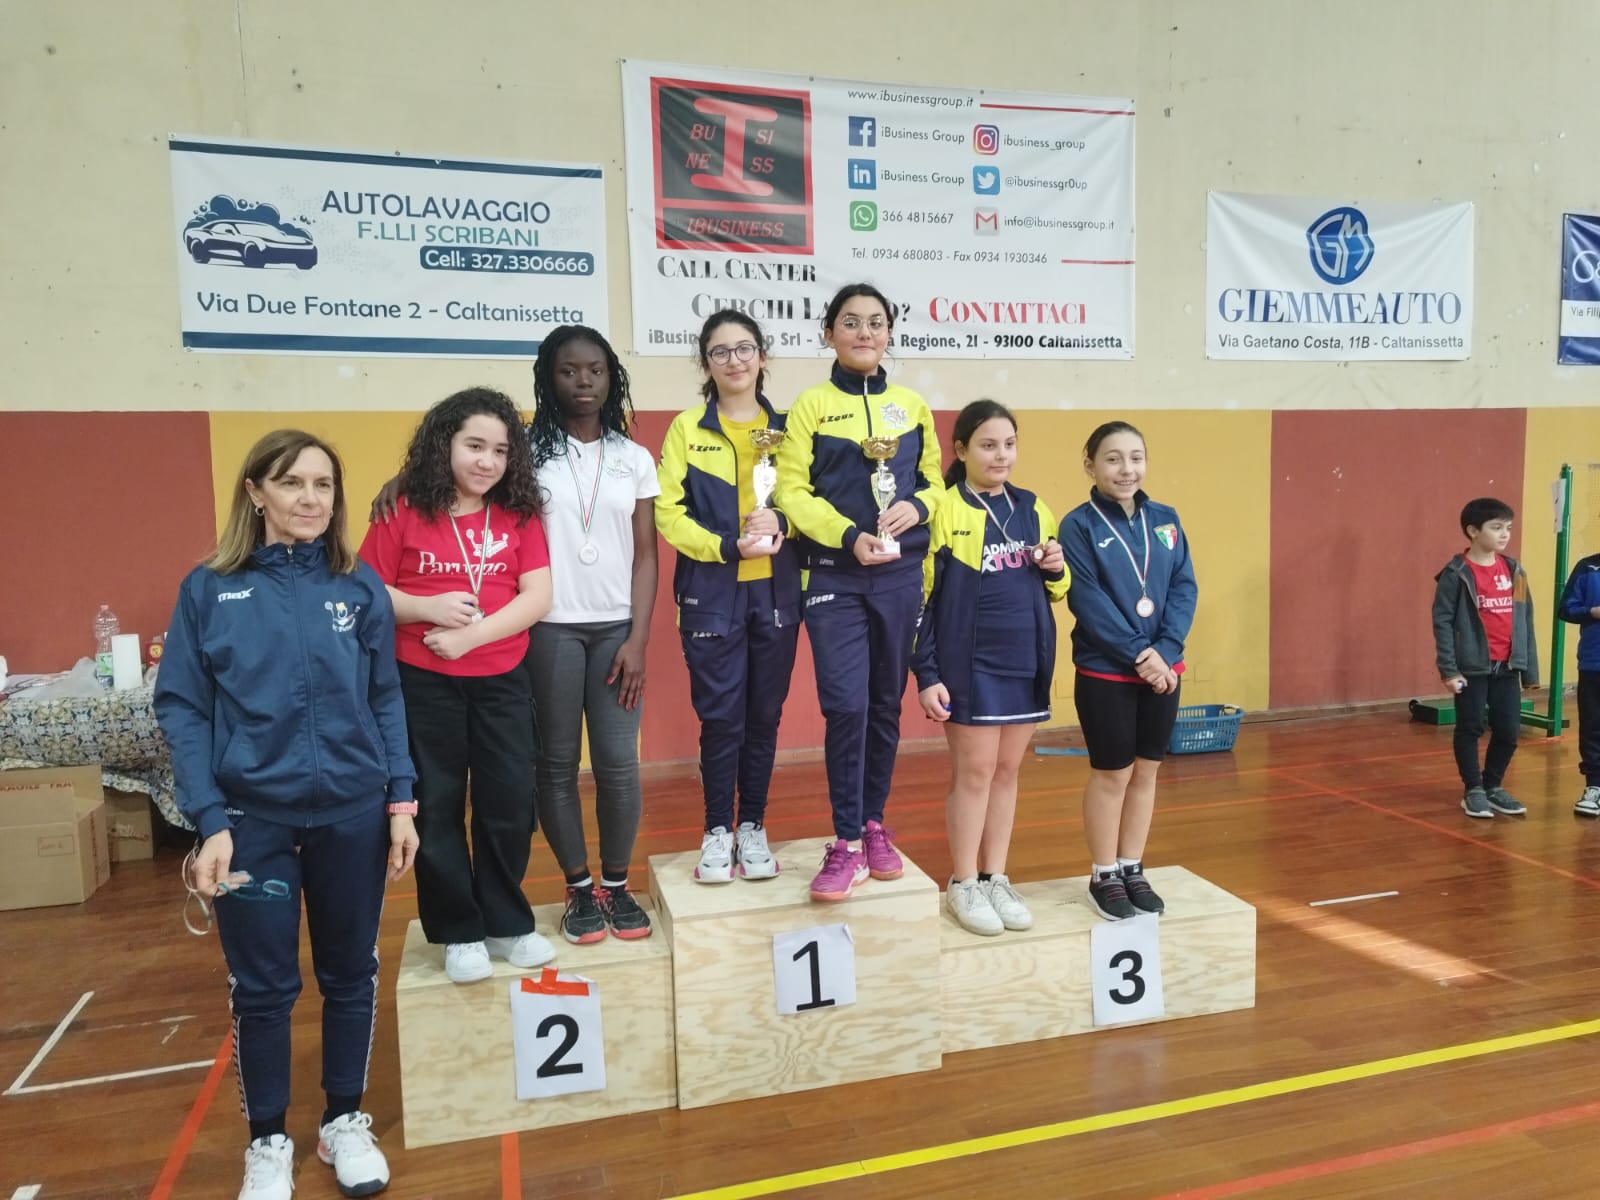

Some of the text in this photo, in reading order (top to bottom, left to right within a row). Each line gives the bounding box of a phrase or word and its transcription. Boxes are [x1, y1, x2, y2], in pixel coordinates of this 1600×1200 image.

[848, 90, 973, 109] www.ibusinessgroup.it
[690, 124, 716, 141] BU
[755, 130, 774, 145] SI
[881, 127, 965, 145] iBusiness Group
[1003, 135, 1085, 151] ibusiness_group
[685, 153, 712, 169] NE
[750, 158, 774, 173] SS
[881, 170, 965, 186] iBusiness Group
[321, 190, 551, 223] AUTOLAVAGGIO
[882, 211, 954, 224] 366 4815667
[1004, 217, 1115, 230] info@ibusinessgroup.it
[358, 222, 539, 247] F.LLI SCRIBANI
[425, 250, 589, 273] Cell: 327.3306666
[851, 248, 868, 260] Tel.
[872, 248, 899, 260] 0934
[903, 249, 943, 261] 680803
[953, 251, 971, 262] Fax
[974, 252, 1000, 262] 0934
[1004, 252, 1047, 264] 1930346
[657, 256, 816, 282] CALL CENTER
[197, 292, 239, 313] Via
[247, 294, 297, 315] Due
[304, 297, 401, 318] Fontane
[408, 302, 422, 319] 2
[445, 301, 584, 324] Caltanissetta
[929, 296, 1086, 324] CONTATTACI
[1218, 288, 1462, 325] GIEMMEAUTO
[780, 332, 801, 346] Srl
[901, 334, 961, 351] Regione,
[966, 335, 978, 347] 21
[994, 335, 1034, 348] 93100
[1038, 335, 1122, 348] Caltanissetta
[1218, 334, 1239, 348] Via
[1243, 334, 1299, 349] Gaetano
[1303, 336, 1344, 350] Costa,
[1349, 336, 1370, 349] 11B
[1381, 336, 1463, 349] Caltanissetta
[792, 939, 835, 1012] 1
[1108, 950, 1146, 1005] 3
[536, 1014, 584, 1079] 2
